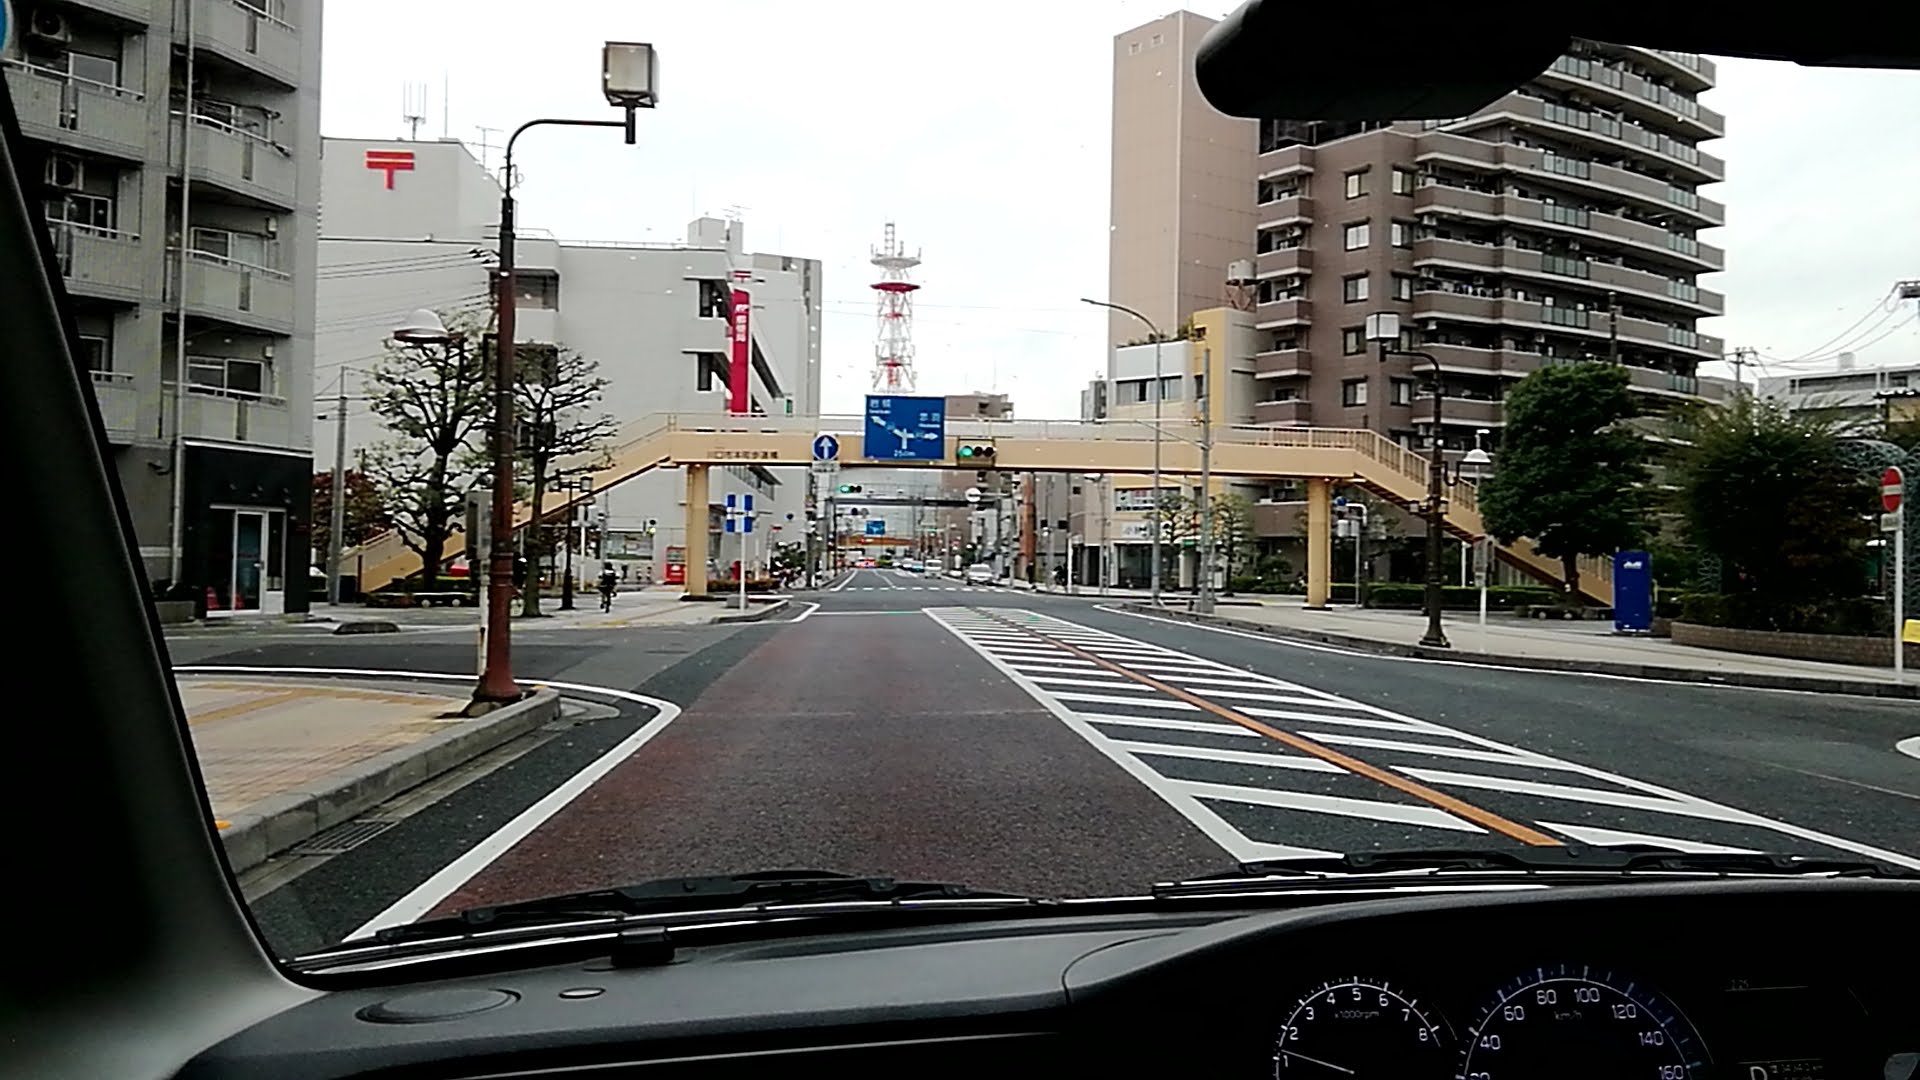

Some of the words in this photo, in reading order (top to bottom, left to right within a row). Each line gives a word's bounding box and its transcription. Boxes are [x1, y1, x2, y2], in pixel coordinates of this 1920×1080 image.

[1327, 991, 1336, 1004] 4
[1352, 988, 1361, 1001] 5
[1379, 993, 1388, 1006] 6
[1537, 990, 1557, 1004] 80
[1574, 988, 1600, 1002] 100
[1306, 1007, 1314, 1020] 3
[1402, 1009, 1411, 1021] 7
[1504, 1006, 1525, 1021] 60
[1612, 1004, 1636, 1019] 120
[1290, 1027, 1299, 1040] 2
[1419, 1027, 1428, 1041] 8
[1639, 1031, 1664, 1045] 140
[1480, 1035, 1501, 1050] 40
[1283, 1054, 1289, 1067] 1
[1658, 1065, 1683, 1080] 160
